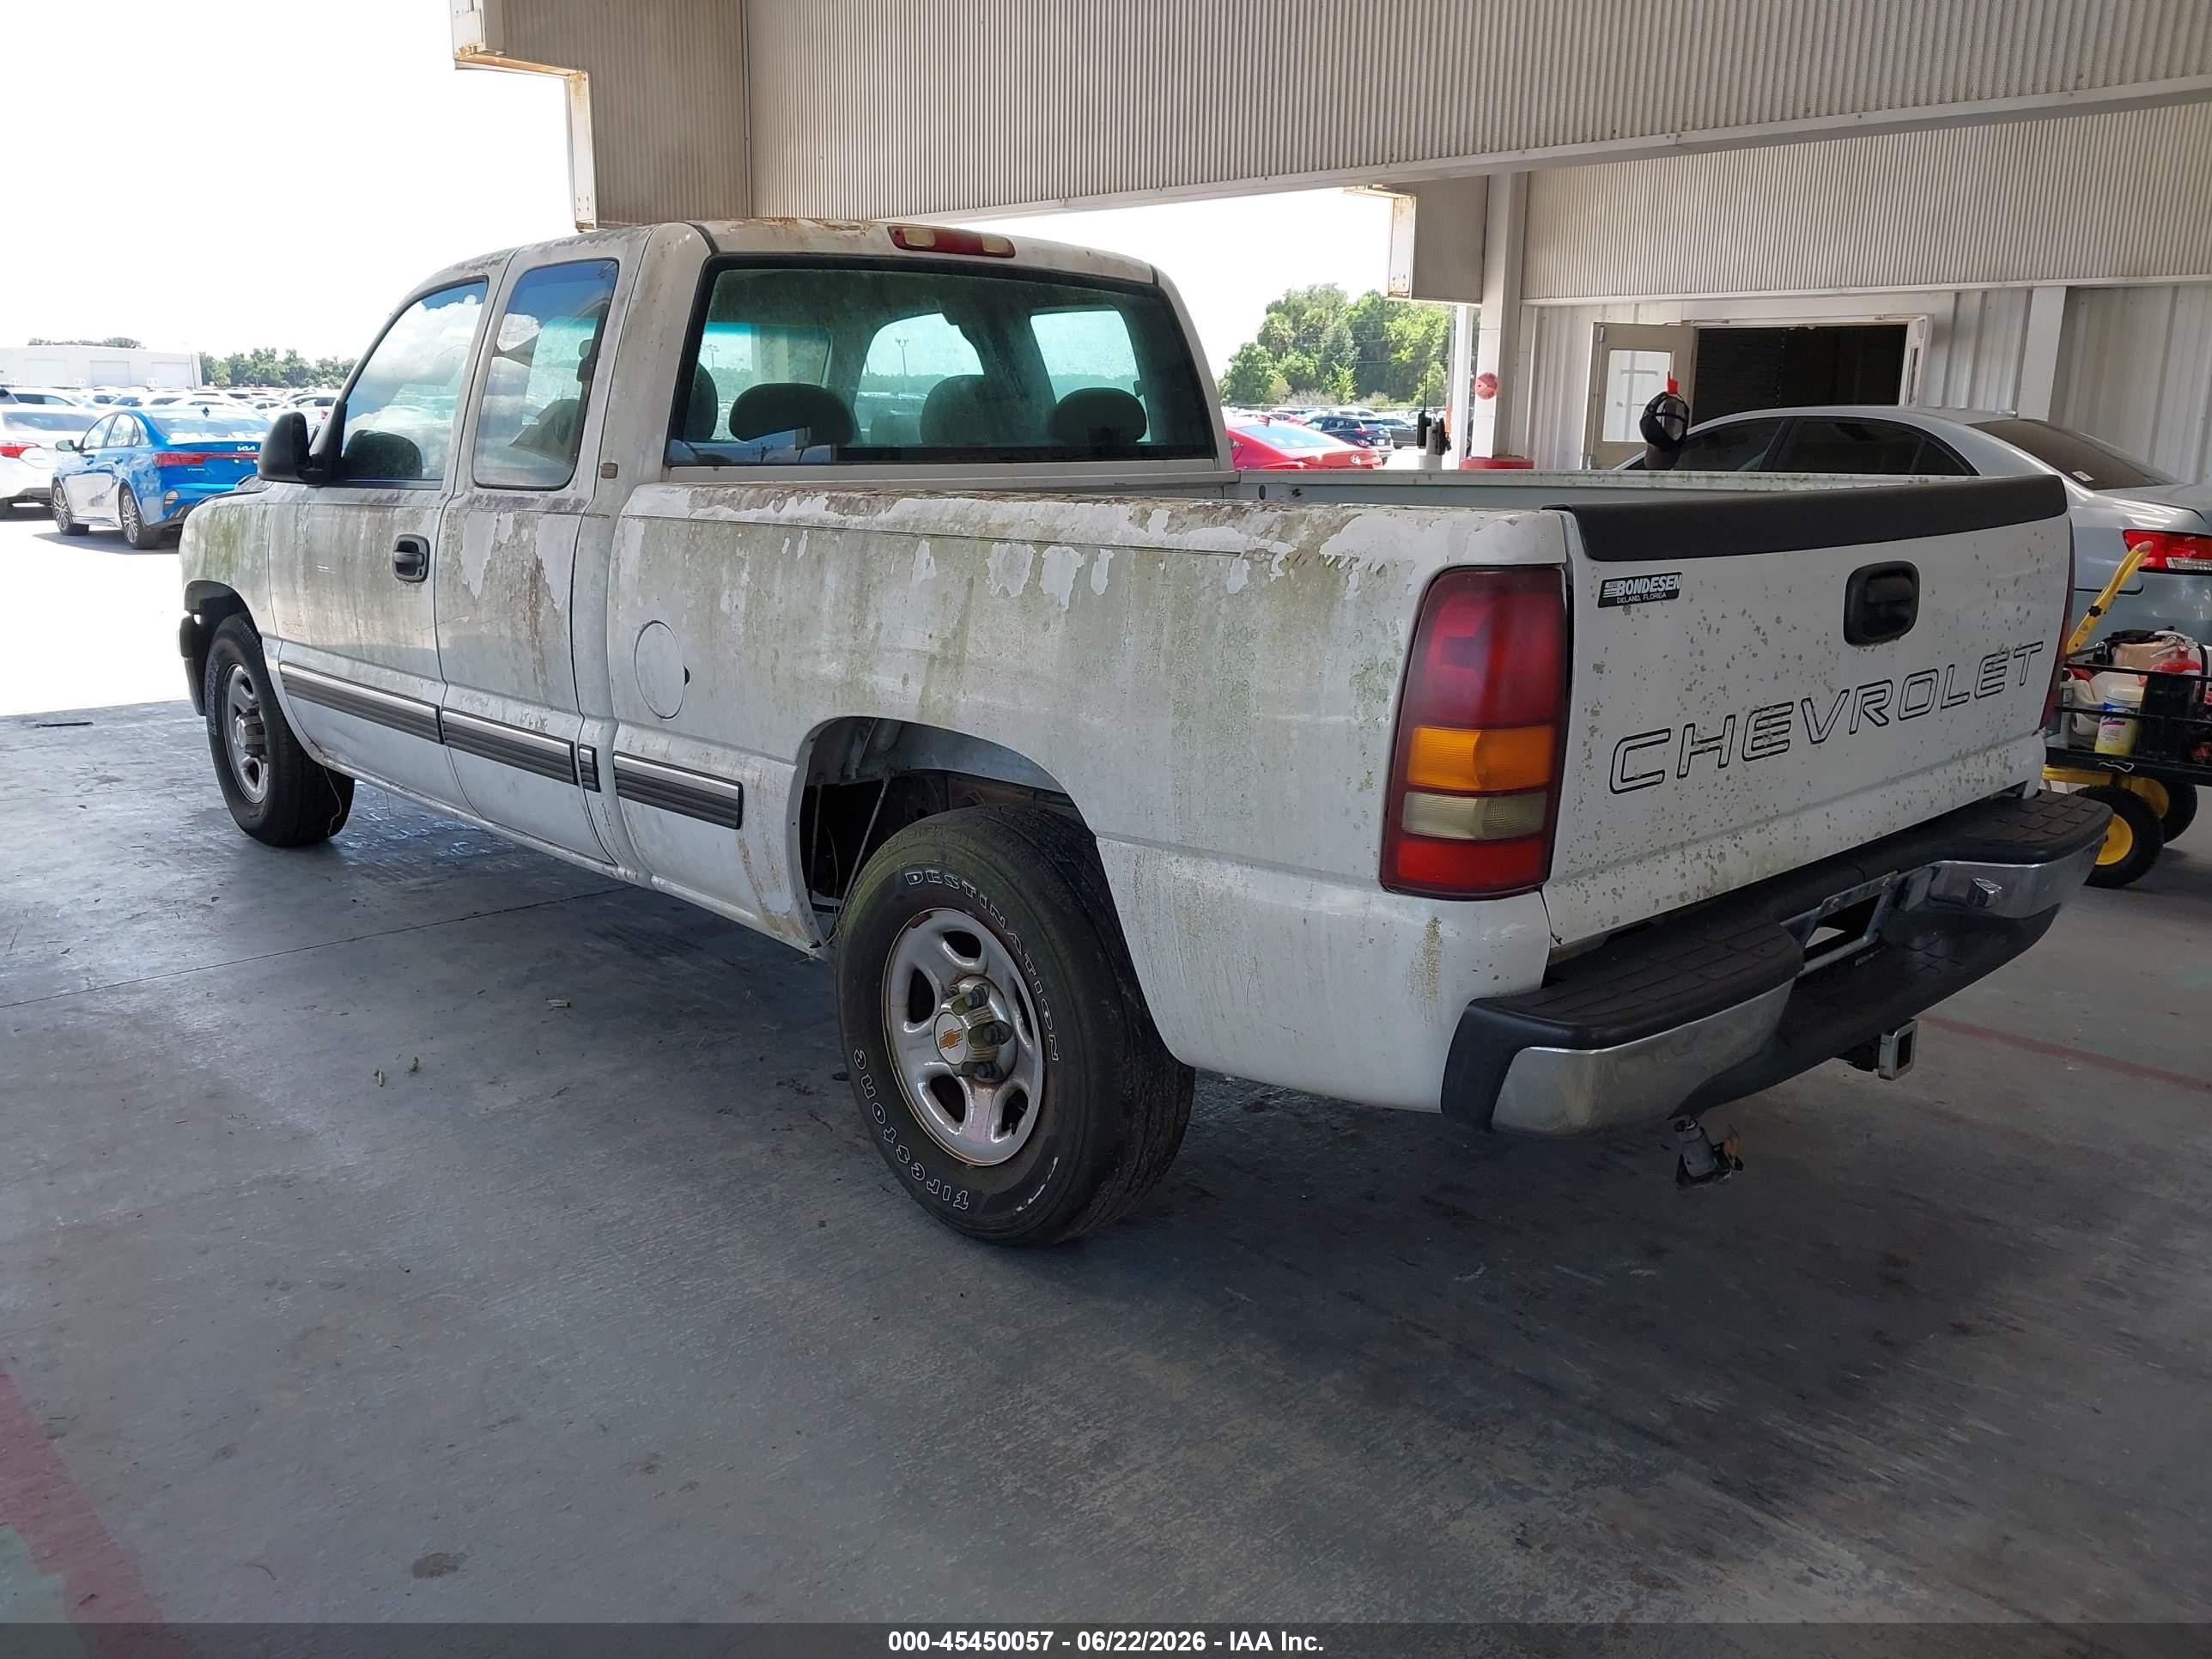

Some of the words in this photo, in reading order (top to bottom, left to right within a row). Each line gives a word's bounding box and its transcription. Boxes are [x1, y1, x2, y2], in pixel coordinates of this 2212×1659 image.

[1616, 574, 1682, 597] BONDESEN
[1643, 592, 1667, 600] FLORIDA
[1609, 641, 2044, 795] CHEVROLET
[905, 870, 1060, 1061] DESTINATION
